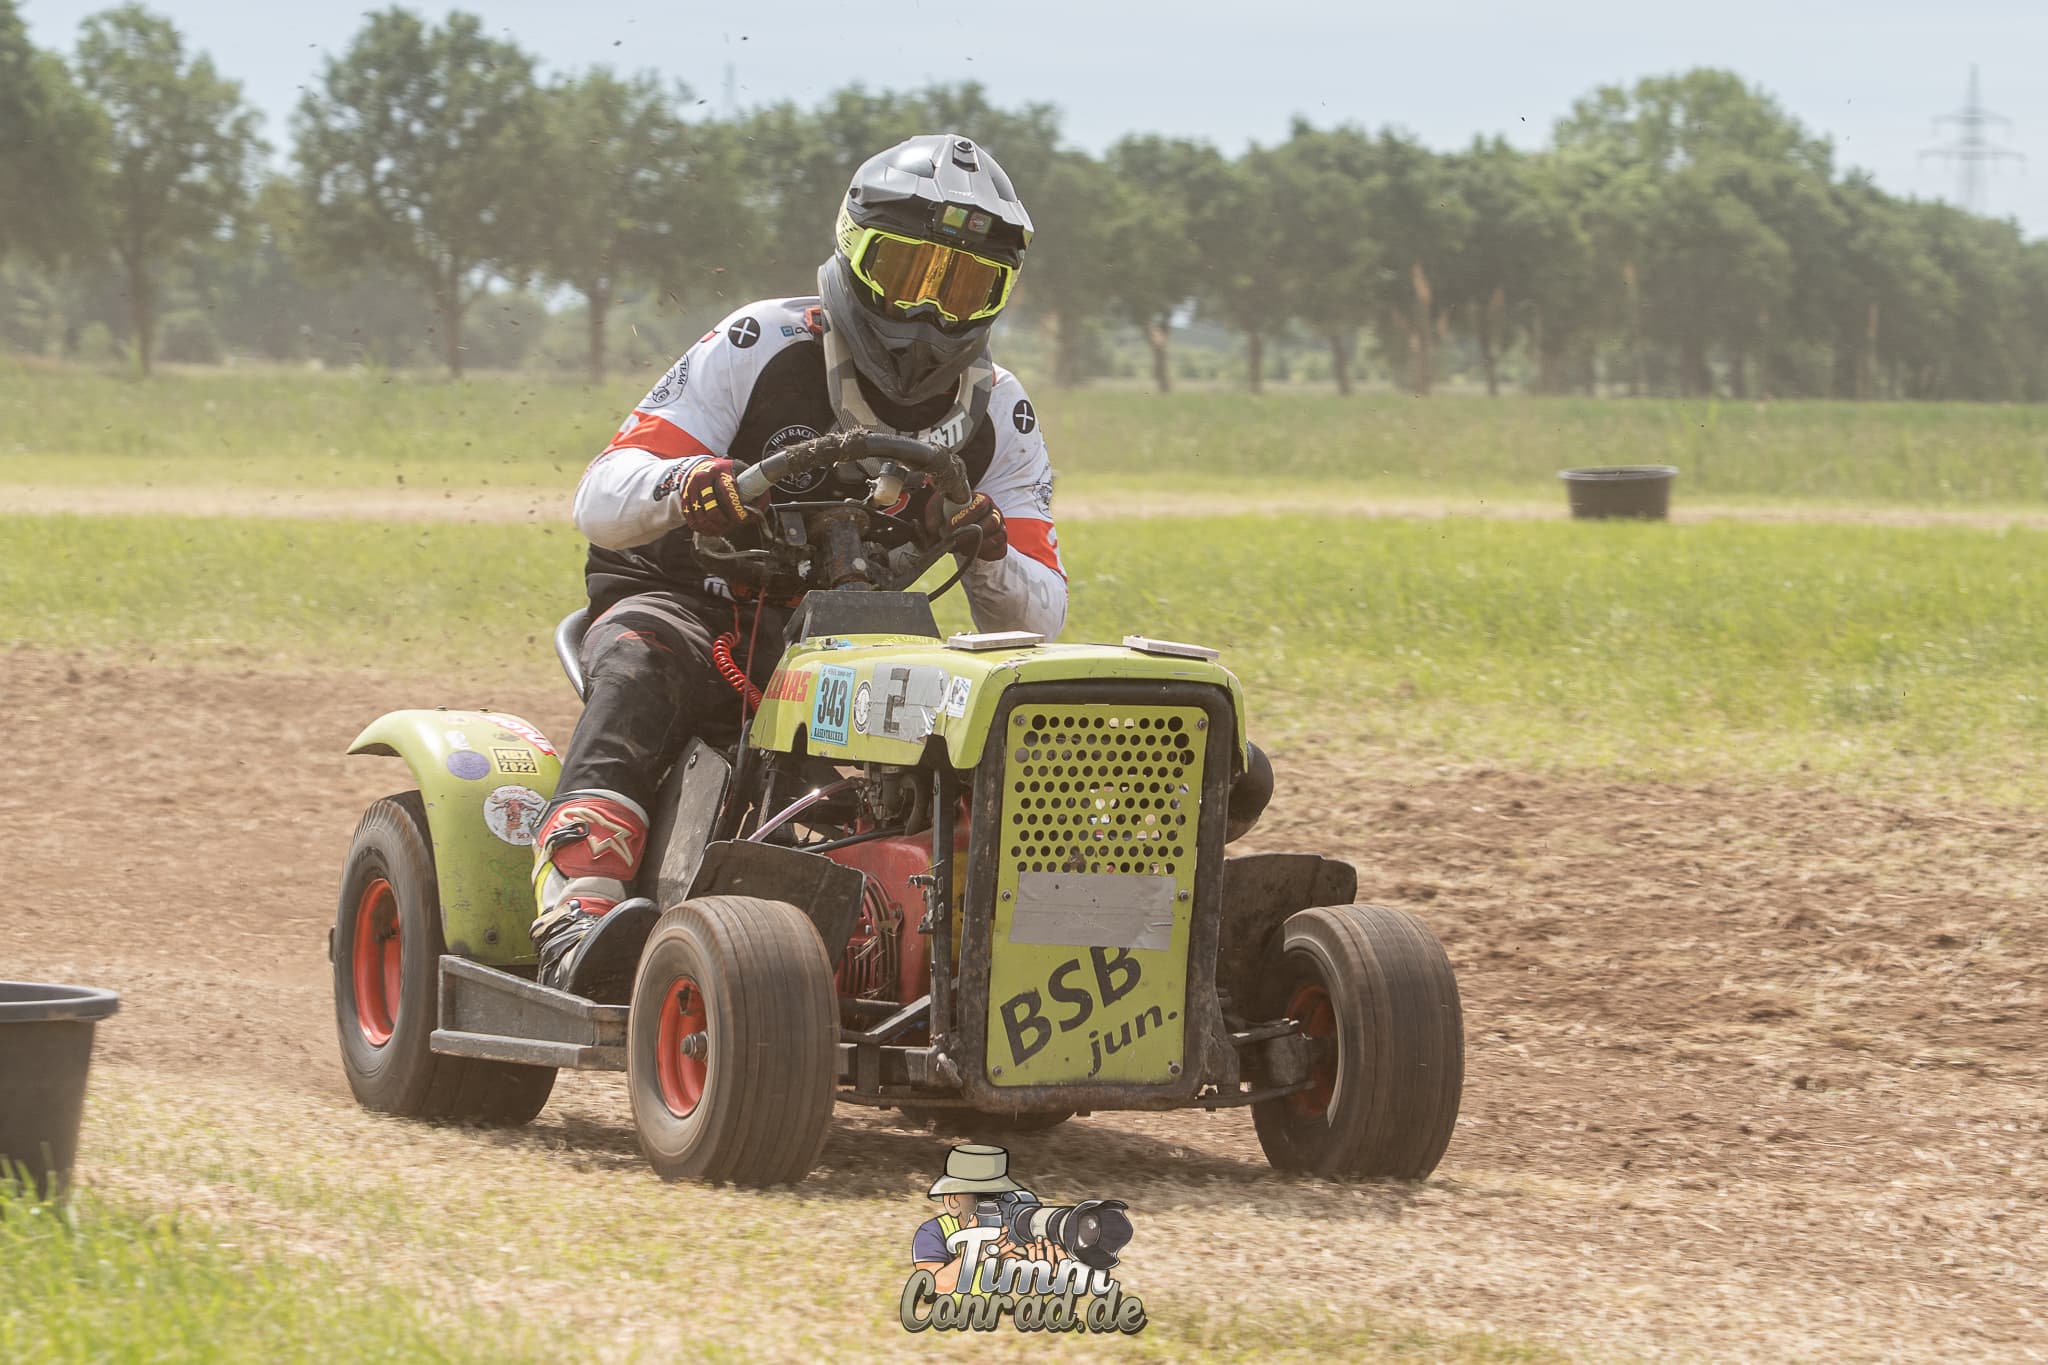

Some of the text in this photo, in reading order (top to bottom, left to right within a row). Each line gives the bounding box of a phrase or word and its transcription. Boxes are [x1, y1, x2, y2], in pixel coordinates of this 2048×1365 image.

[677, 360, 687, 385] TEAM
[817, 677, 848, 728] 343
[999, 946, 1142, 1067] BSB
[1087, 1004, 1179, 1079] jun.
